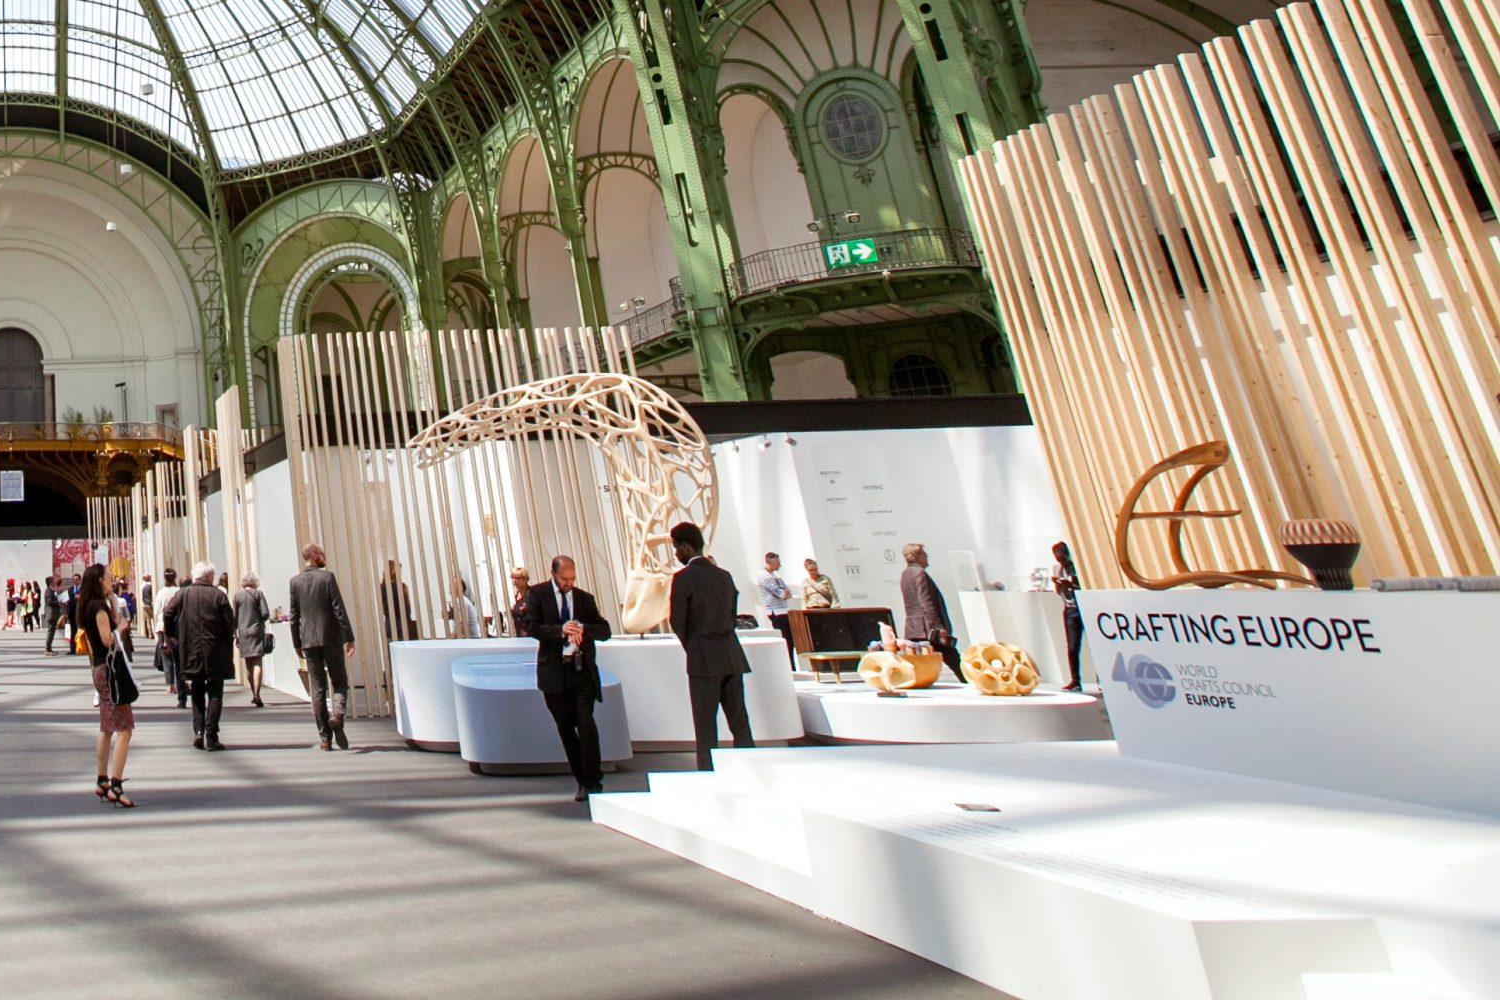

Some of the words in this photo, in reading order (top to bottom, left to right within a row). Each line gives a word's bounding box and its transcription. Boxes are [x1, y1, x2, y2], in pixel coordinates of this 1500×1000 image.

[1097, 612, 1236, 645] CRAFTING
[1237, 615, 1381, 653] EUROPE
[1175, 664, 1218, 679] WORLD
[1180, 678, 1221, 693] CRAFTS
[1222, 681, 1277, 698] COUNCIL
[1185, 693, 1236, 710] EUROPE
